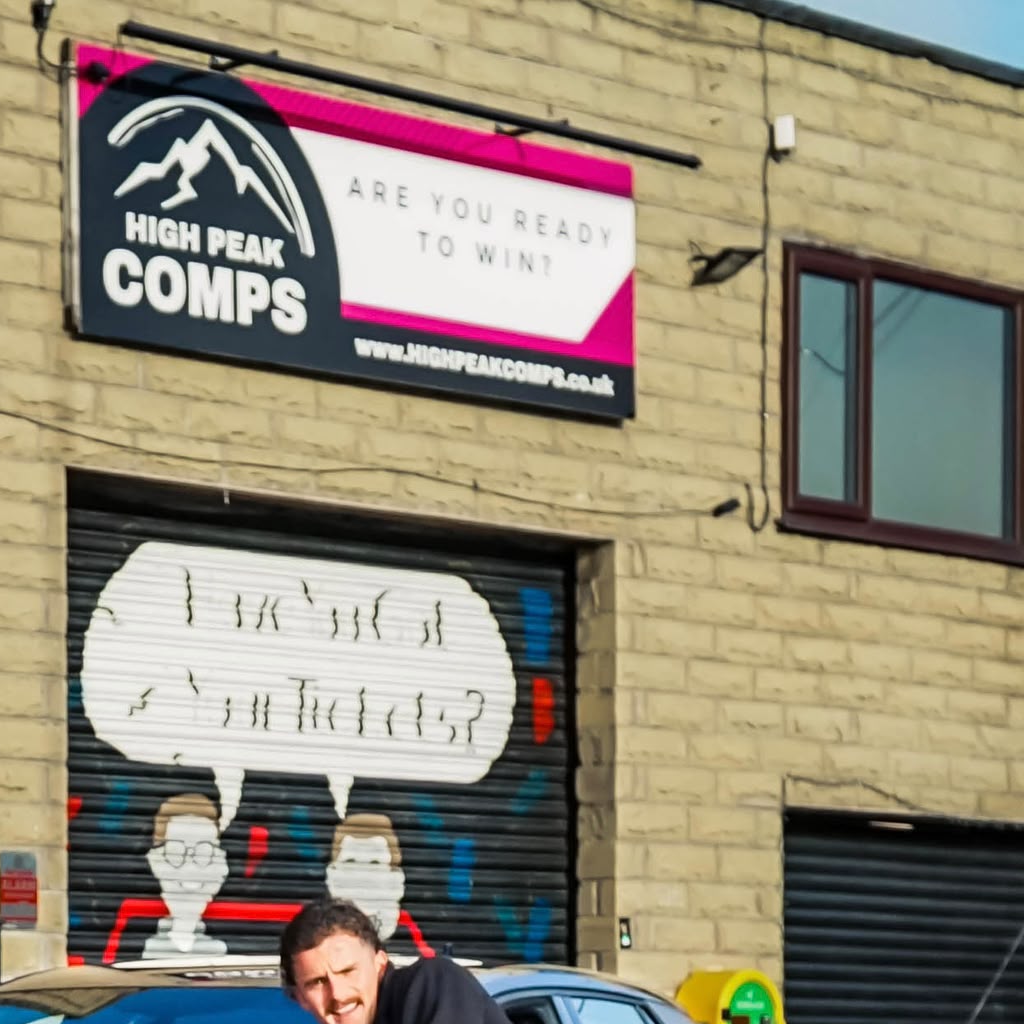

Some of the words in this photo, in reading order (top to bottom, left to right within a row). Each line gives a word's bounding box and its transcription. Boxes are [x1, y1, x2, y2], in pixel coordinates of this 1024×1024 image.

[125, 211, 201, 253] HIGH
[206, 226, 285, 268] PEAK
[347, 176, 409, 208] ARE
[430, 192, 492, 224] YOU
[513, 209, 611, 249] READY
[417, 231, 454, 257] TO
[475, 242, 552, 277] WIN?
[102, 248, 308, 335] COMPS
